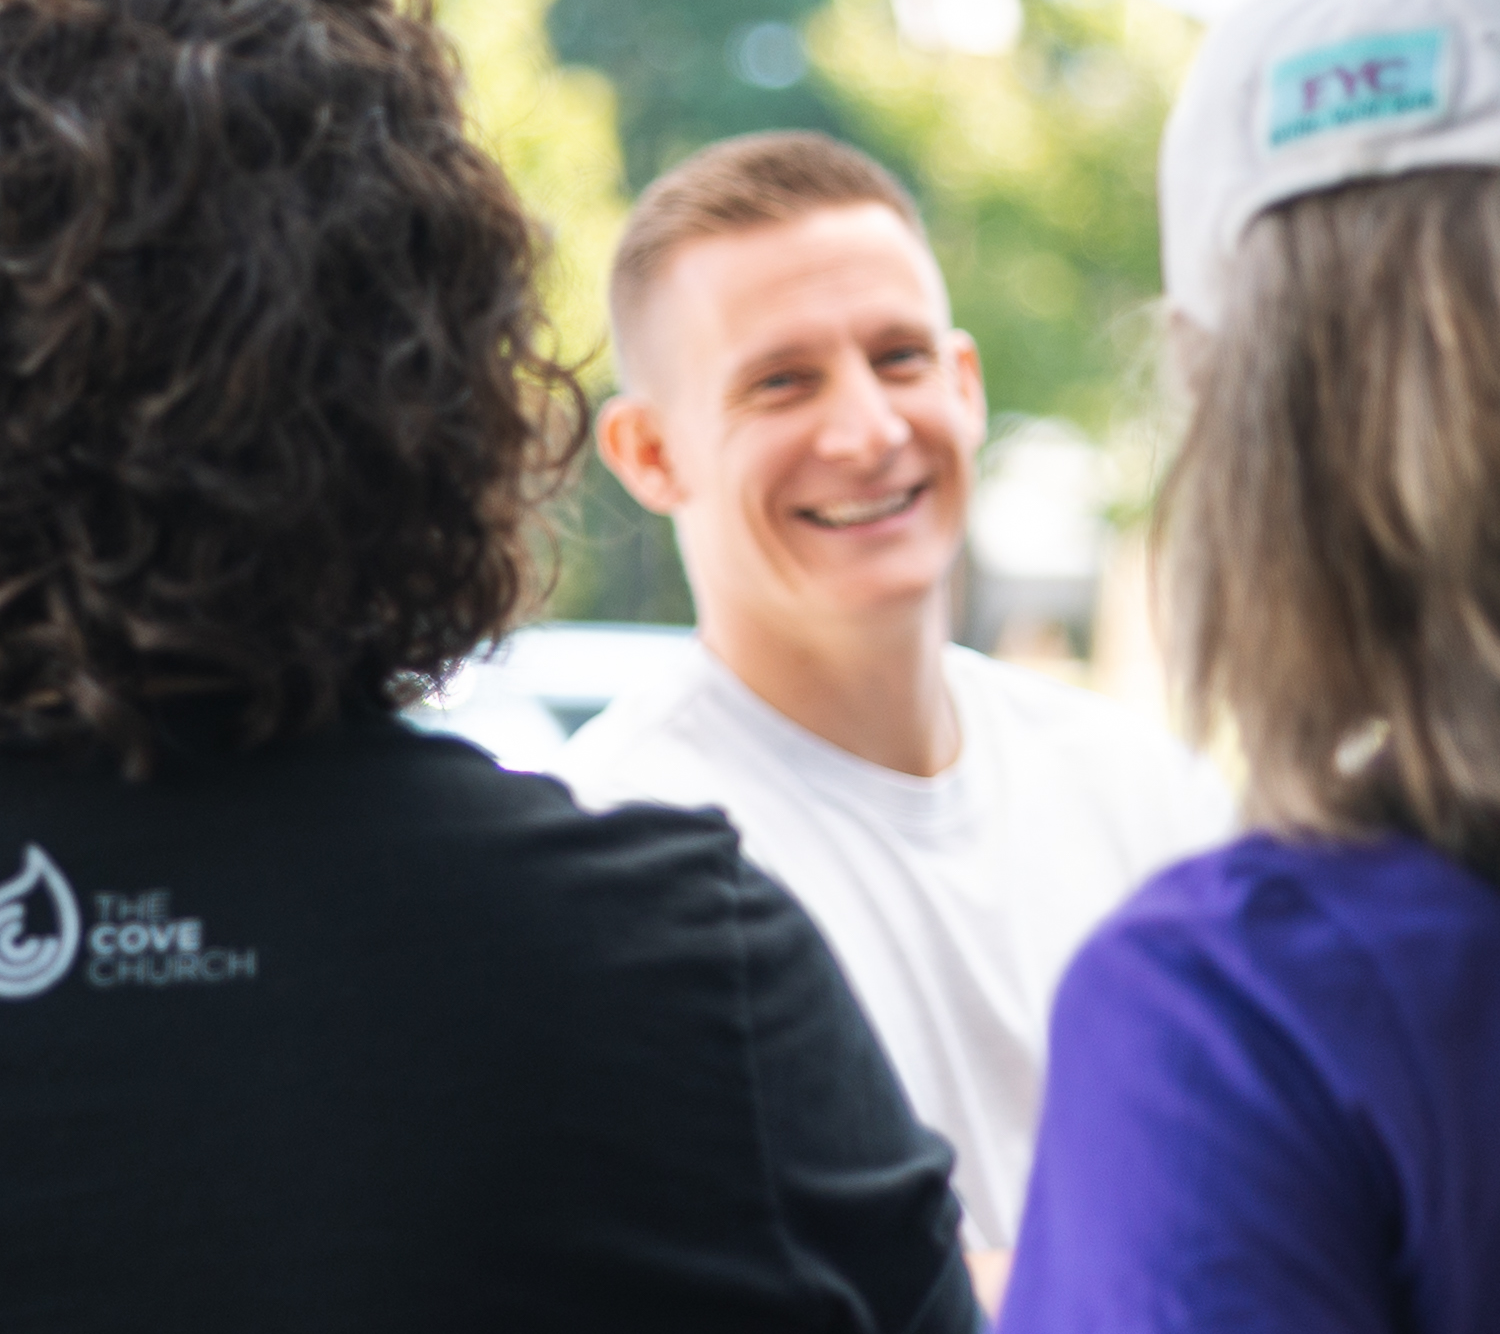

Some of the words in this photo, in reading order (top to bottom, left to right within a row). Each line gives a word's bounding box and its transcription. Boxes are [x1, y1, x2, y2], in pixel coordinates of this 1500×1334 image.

[94, 888, 171, 919] THE
[91, 919, 202, 956] COVE
[88, 948, 257, 986] CHURCH
